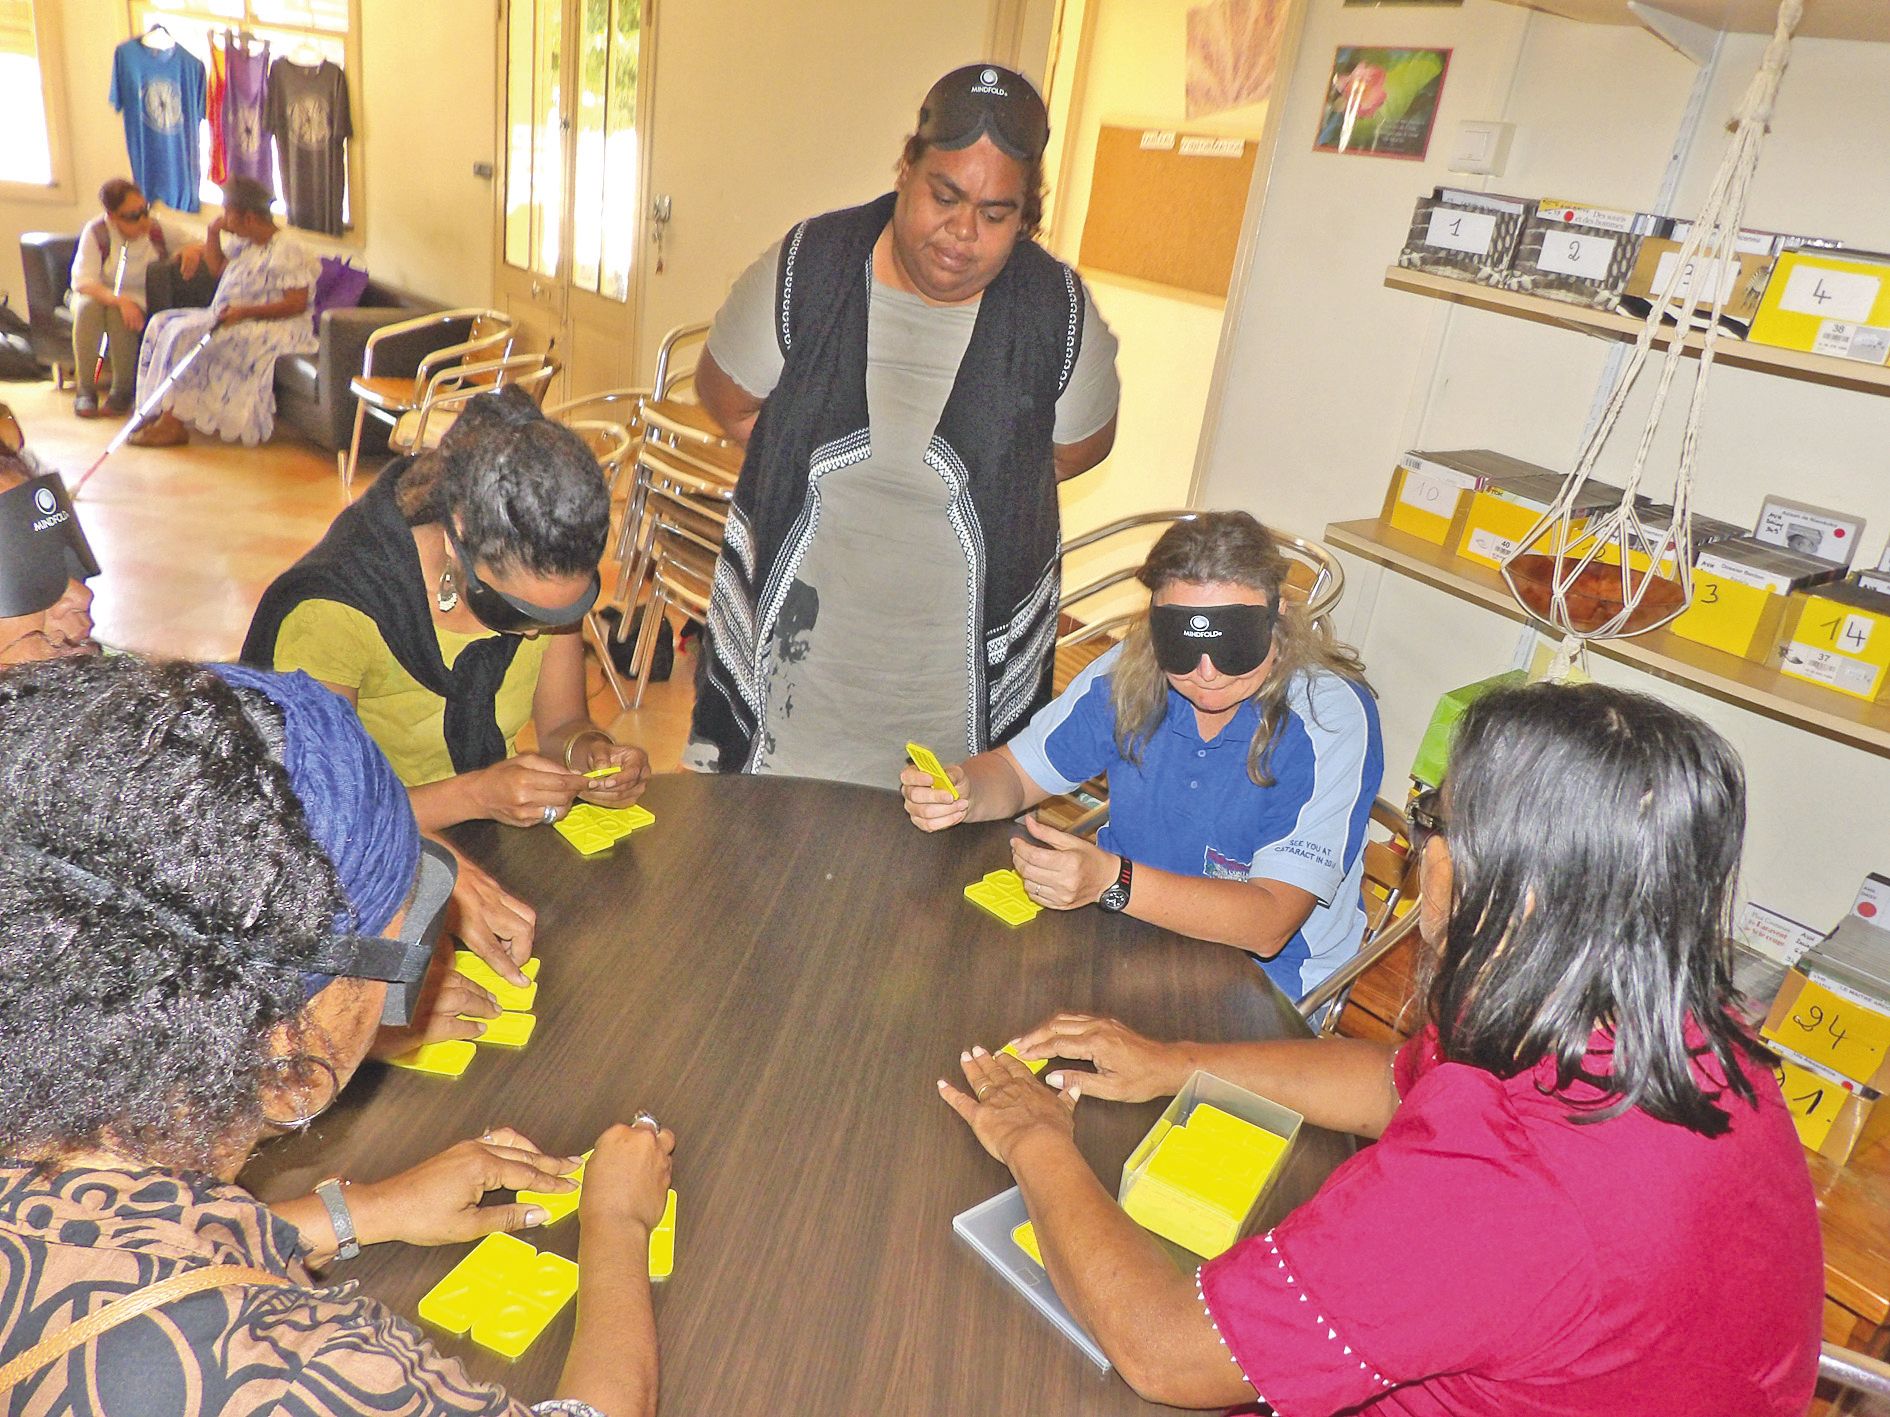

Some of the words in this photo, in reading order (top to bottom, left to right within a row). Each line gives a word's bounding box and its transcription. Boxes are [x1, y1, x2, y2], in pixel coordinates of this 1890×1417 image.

[971, 86, 1004, 96] MINDFOLD
[1449, 218, 1460, 237] 1
[1568, 240, 1580, 262] 2
[1813, 278, 1832, 305] 4
[1418, 481, 1440, 501] 10
[34, 510, 69, 532] MINDFOLD
[1501, 541, 1511, 549] 40
[1183, 630, 1220, 638] MINDFOLD
[1820, 617, 1867, 648] 14
[1818, 653, 1831, 662] 37
[1274, 846, 1316, 860] CATARACT
[1316, 856, 1323, 864] IN
[1289, 839, 1304, 847] SEE
[1306, 841, 1321, 852] YOU
[1322, 847, 1332, 856] AT
